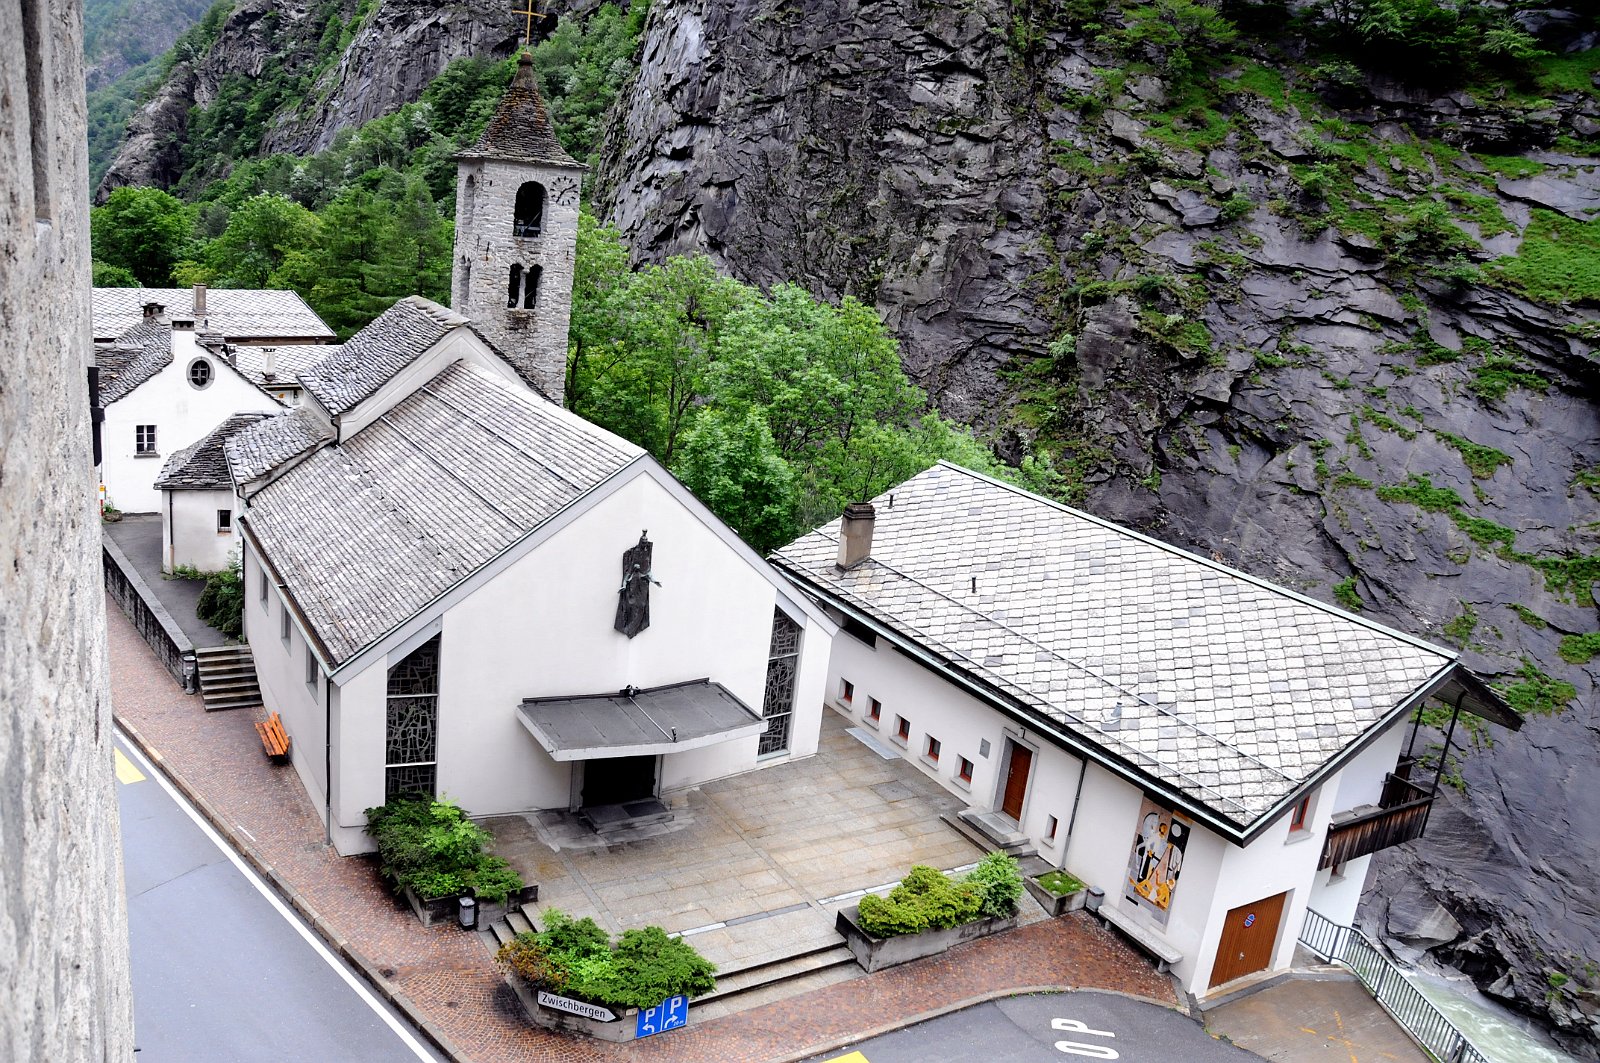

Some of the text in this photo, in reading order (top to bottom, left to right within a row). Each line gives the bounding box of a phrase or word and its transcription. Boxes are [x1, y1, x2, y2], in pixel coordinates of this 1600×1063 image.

[542, 994, 606, 1018] Zwischbergen
[670, 996, 682, 1015] P
[645, 1008, 656, 1023] P
